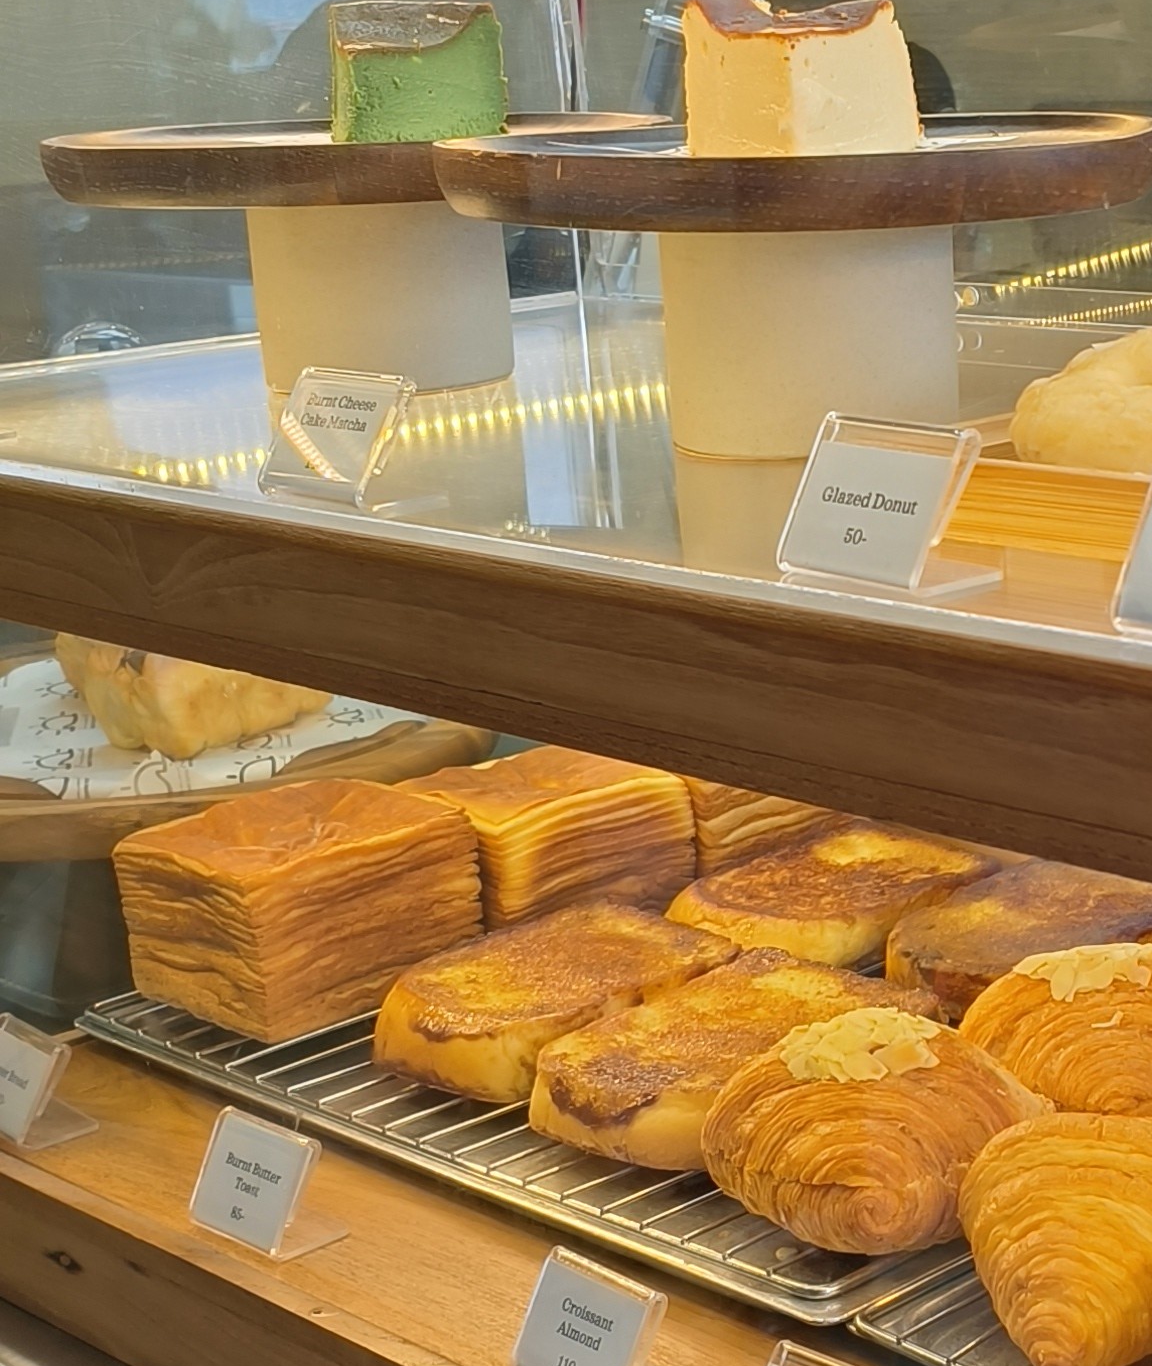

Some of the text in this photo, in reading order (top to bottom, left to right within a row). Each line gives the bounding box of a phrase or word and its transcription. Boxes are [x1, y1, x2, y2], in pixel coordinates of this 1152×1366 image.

[306, 393, 377, 412] Burnt Cheese
[300, 413, 367, 432] Cake Matcha
[822, 486, 918, 515] Glazed Donut
[843, 527, 867, 545] 50-
[226, 1151, 282, 1185] Burnt Butter
[235, 1177, 260, 1197] Toast
[562, 1297, 614, 1332] Croissant
[556, 1321, 602, 1351] Almond
